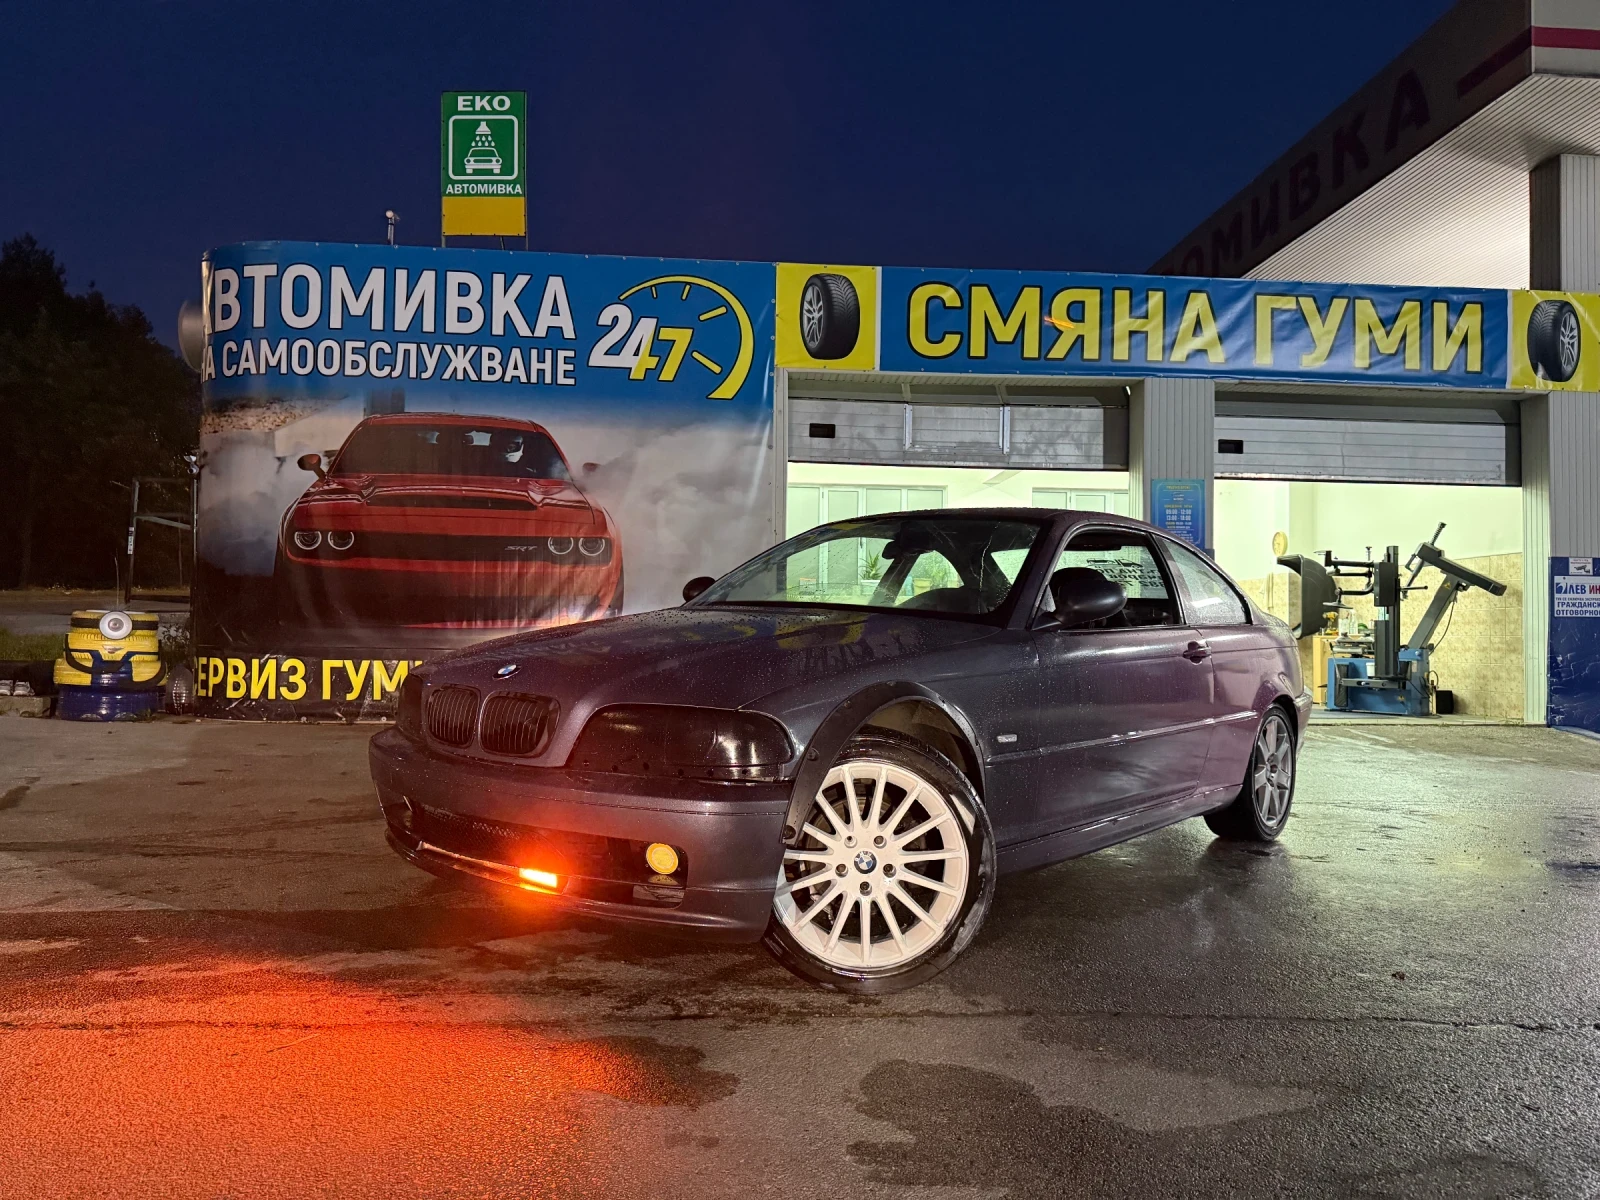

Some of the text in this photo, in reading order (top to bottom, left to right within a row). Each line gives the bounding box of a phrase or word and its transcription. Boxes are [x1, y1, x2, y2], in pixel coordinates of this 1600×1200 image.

[457, 95, 511, 112] ЕКО
[445, 183, 522, 195] АВТОМИВКА
[1160, 68, 1431, 277] ОМИВКА
[906, 282, 1484, 374] СМЯНА ГУМИ
[221, 338, 577, 386] САМООБСЛУЖВАНЕ
[1569, 584, 1586, 594] ЛЕВ
[321, 658, 423, 701] ГУМ
